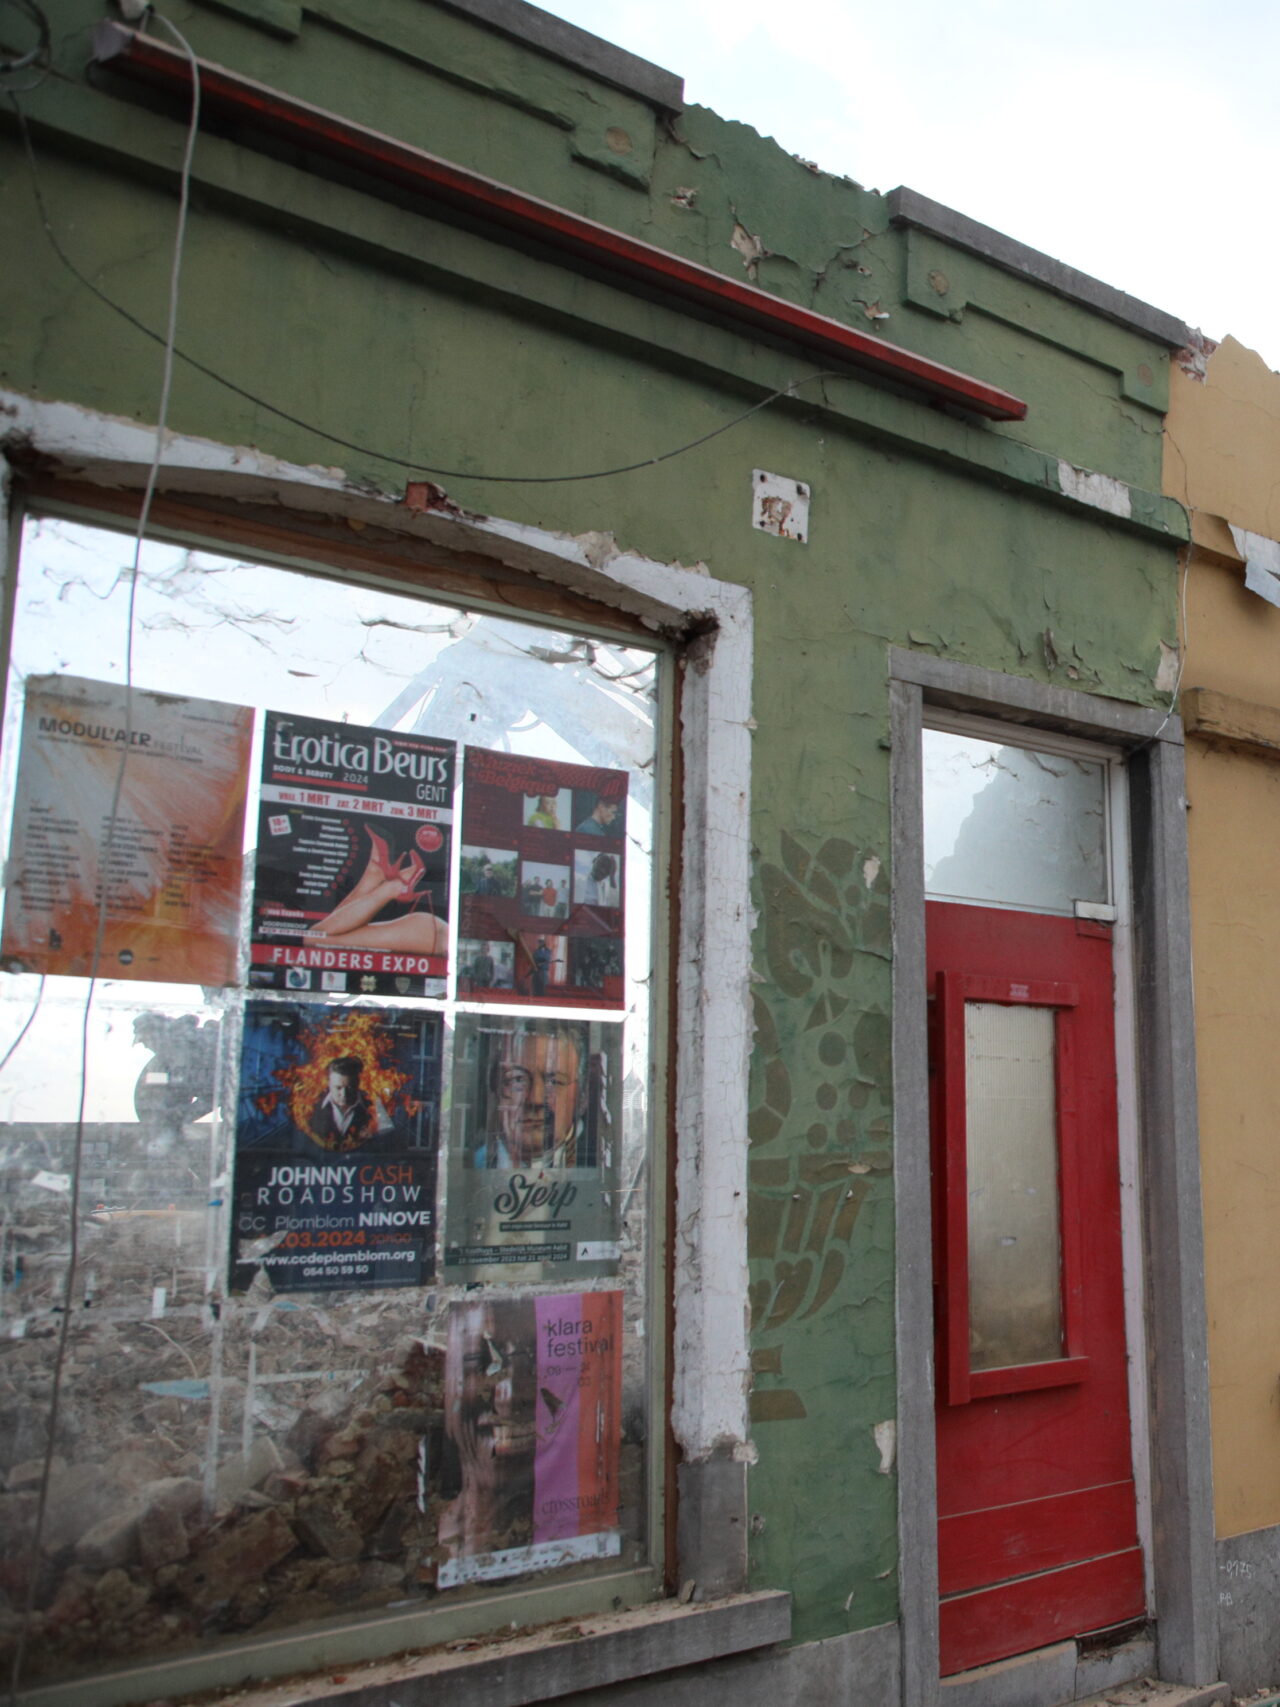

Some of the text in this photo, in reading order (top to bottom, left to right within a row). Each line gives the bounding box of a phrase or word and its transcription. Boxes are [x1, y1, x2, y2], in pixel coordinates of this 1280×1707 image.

[273, 721, 448, 783] Erotica Beurs
[343, 772, 369, 784] 2024
[416, 783, 448, 802] GENT
[300, 792, 305, 802] 1
[307, 793, 331, 806] MRT
[353, 799, 360, 810] 2
[362, 801, 385, 813] MRT
[408, 806, 414, 817] 3
[416, 807, 439, 820] MRT
[271, 948, 430, 973] FLANDERS EXPO
[267, 1165, 413, 1187] JOHNNY CASH
[257, 1185, 421, 1206] ROADSHOW
[493, 1171, 578, 1221] Sjerp
[275, 1215, 354, 1230] Plomblom
[359, 1211, 431, 1227] NINOVE
[260, 1230, 367, 1249] .03.2024
[547, 1318, 593, 1337] klara
[547, 1337, 614, 1358] festival
